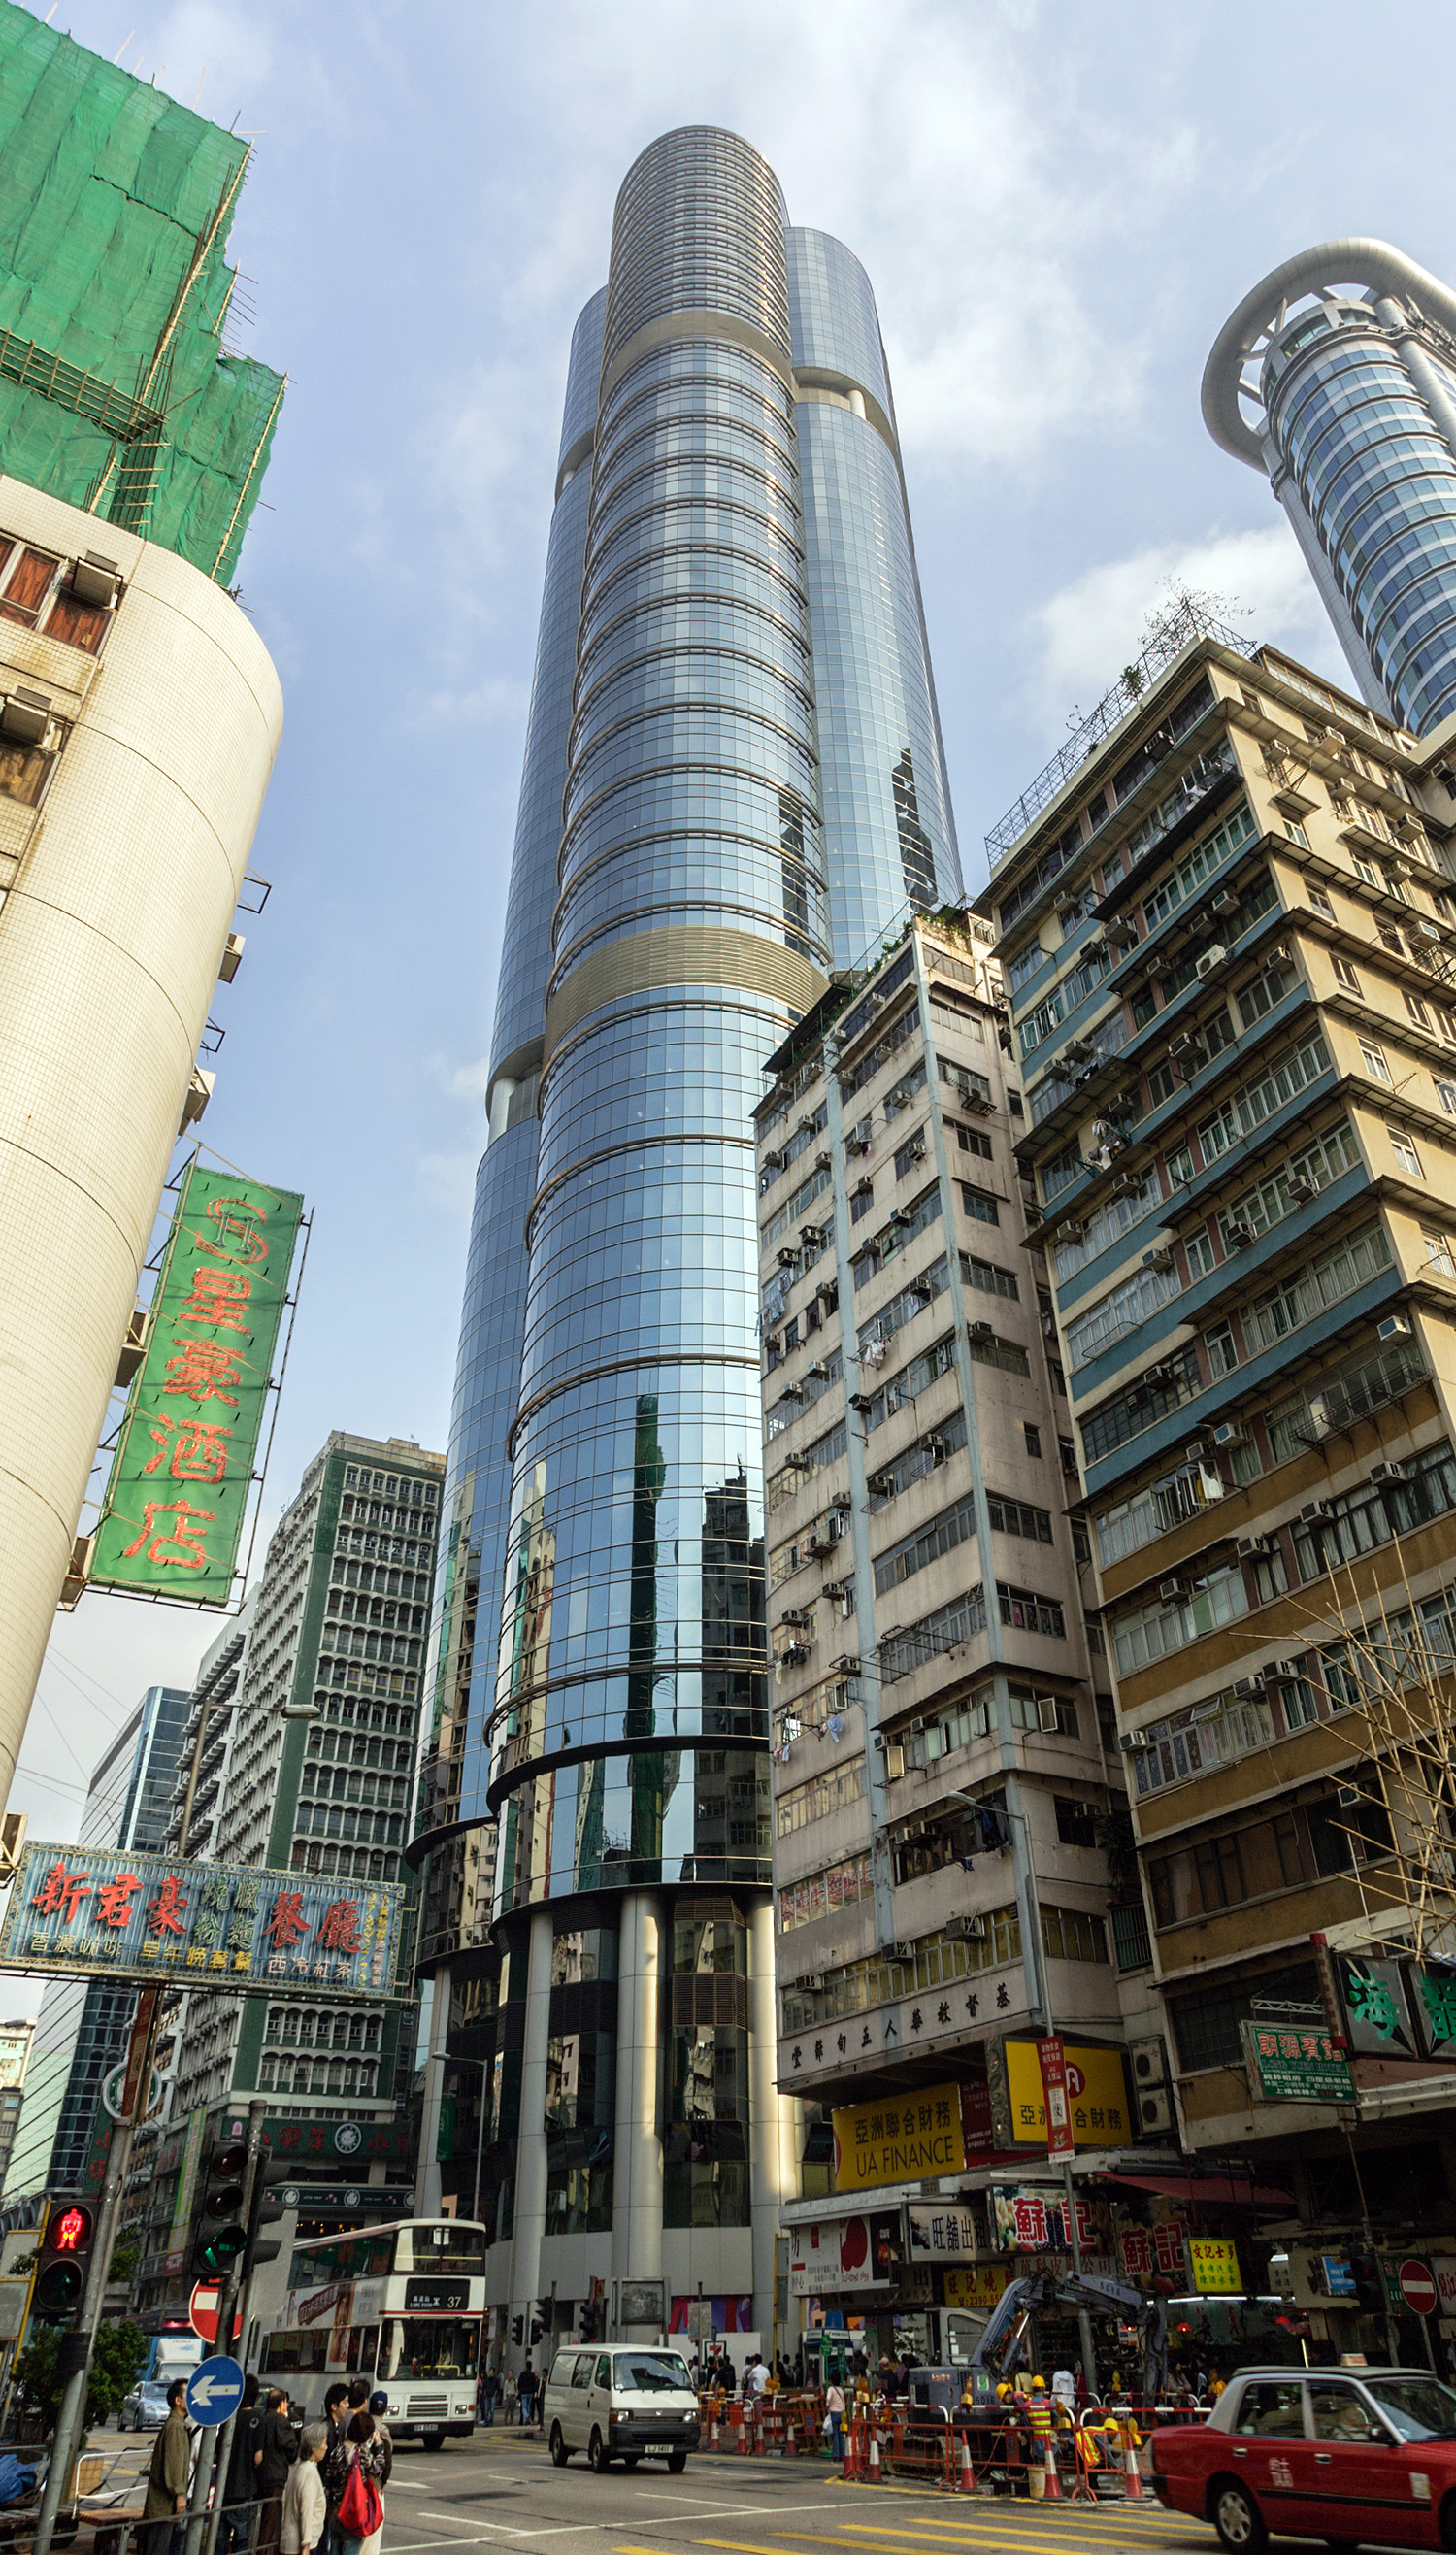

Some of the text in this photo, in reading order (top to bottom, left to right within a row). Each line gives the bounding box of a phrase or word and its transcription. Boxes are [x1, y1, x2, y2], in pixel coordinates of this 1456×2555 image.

[124, 1267, 253, 1570] 星豪酒店
[31, 1860, 189, 1937] 新君豪
[262, 1891, 364, 1955] 餐廳
[139, 1941, 253, 1973] 早午晚套餐
[267, 1954, 352, 1982] 西冷紅茶
[854, 2100, 951, 2146] 亞洲聯合財務
[856, 2151, 879, 2178] UA
[882, 2135, 955, 2173] FINANCE
[1011, 2197, 1097, 2245] 蘇記
[1121, 2222, 1186, 2275] 蘇記
[447, 2295, 462, 2309] 37
